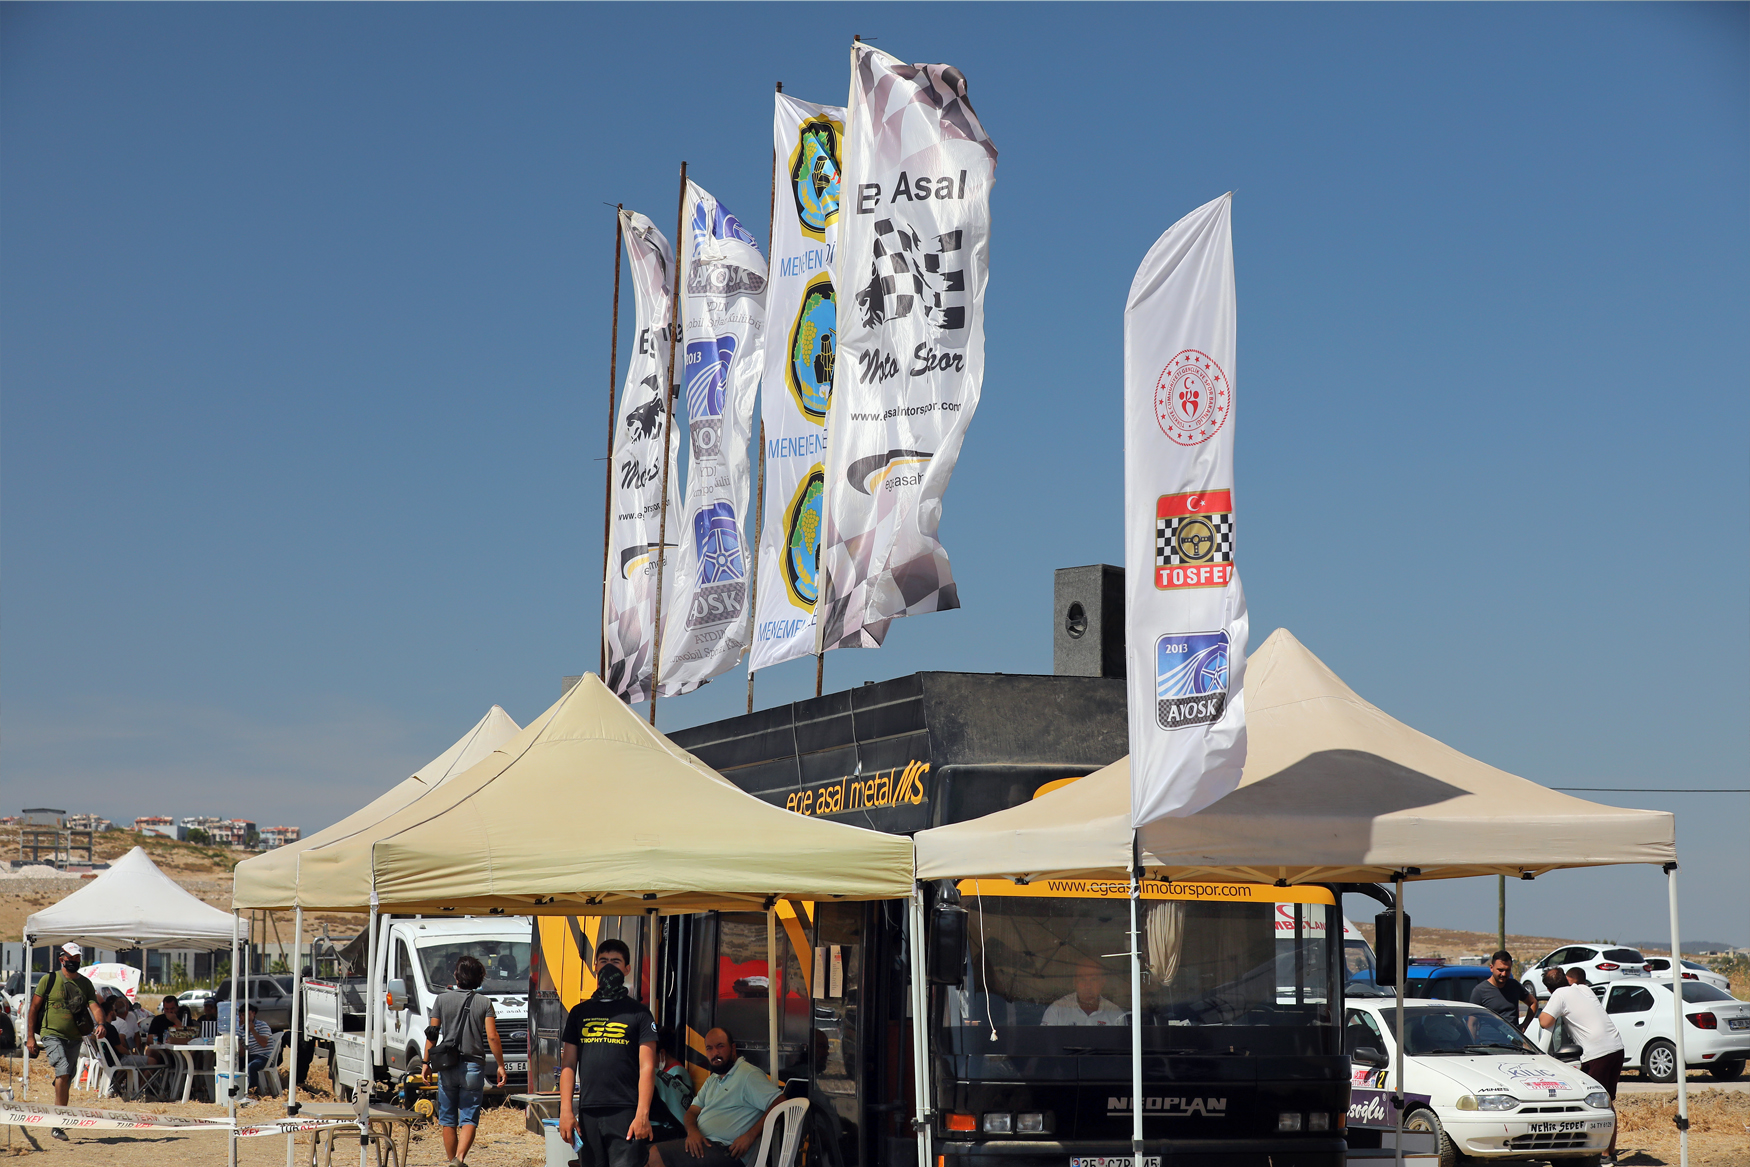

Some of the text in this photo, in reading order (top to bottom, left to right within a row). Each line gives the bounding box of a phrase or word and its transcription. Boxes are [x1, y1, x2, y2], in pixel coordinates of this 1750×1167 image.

[890, 169, 968, 204] Asal
[1165, 643, 1188, 654] 2013
[1167, 698, 1218, 722] AYOSK
[816, 775, 848, 815] asal
[849, 767, 896, 809] metal
[1048, 880, 1253, 899] www.egeaslmotorspor.com
[581, 1021, 629, 1038] GS
[603, 1037, 630, 1045] TURKEY
[1377, 1071, 1386, 1089] 2
[2, 1103, 25, 1113] OPEL
[26, 1105, 51, 1115] TEAM
[54, 1107, 78, 1117] OPEL
[78, 1109, 105, 1119] TEAM
[9, 1113, 44, 1124] TURKEY
[61, 1118, 98, 1128] TURKEY
[1558, 1121, 1585, 1133] SEDEF
